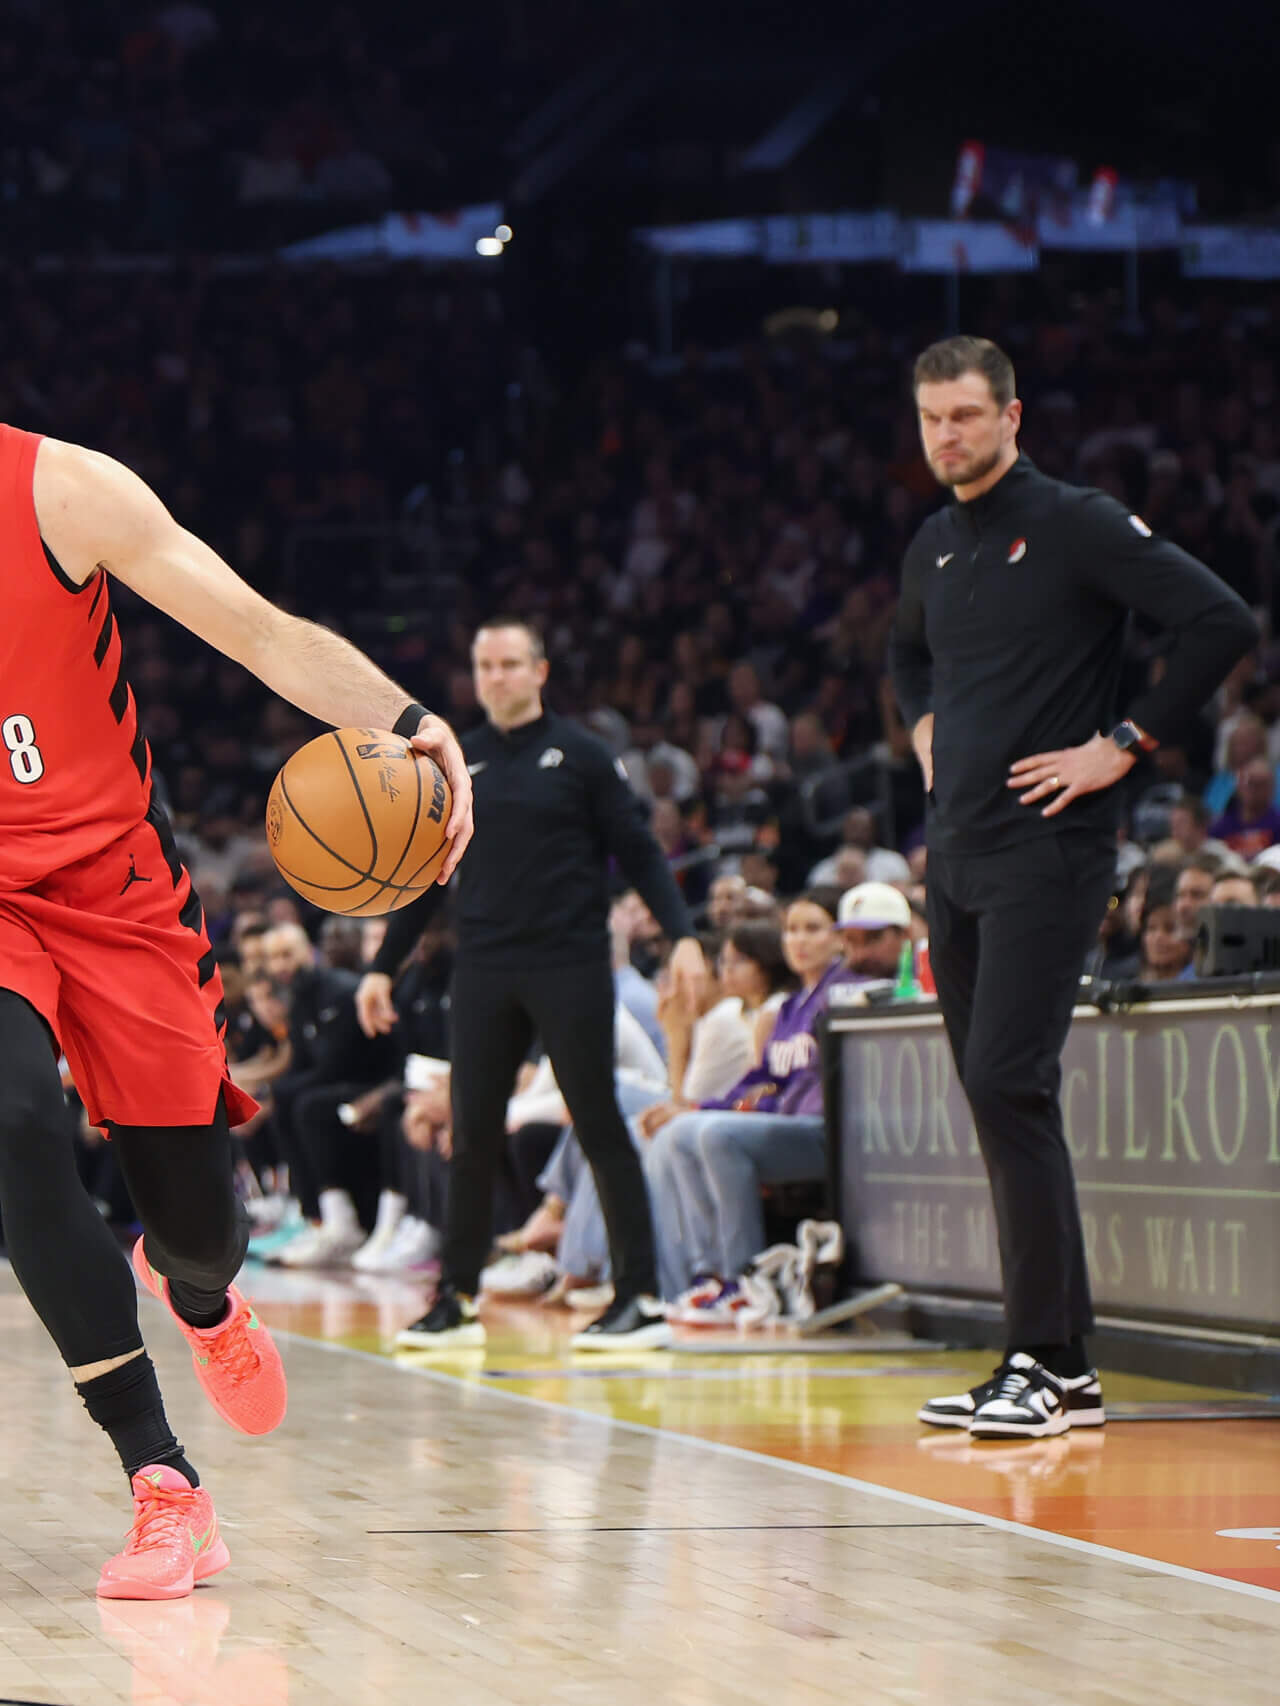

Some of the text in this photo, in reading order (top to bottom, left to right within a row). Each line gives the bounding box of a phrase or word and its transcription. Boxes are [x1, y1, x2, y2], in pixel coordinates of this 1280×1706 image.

[1, 713, 45, 784] 8
[862, 1037, 980, 1157] ROR
[894, 1201, 950, 1269] THE
[1144, 1215, 1246, 1297] WAIT
